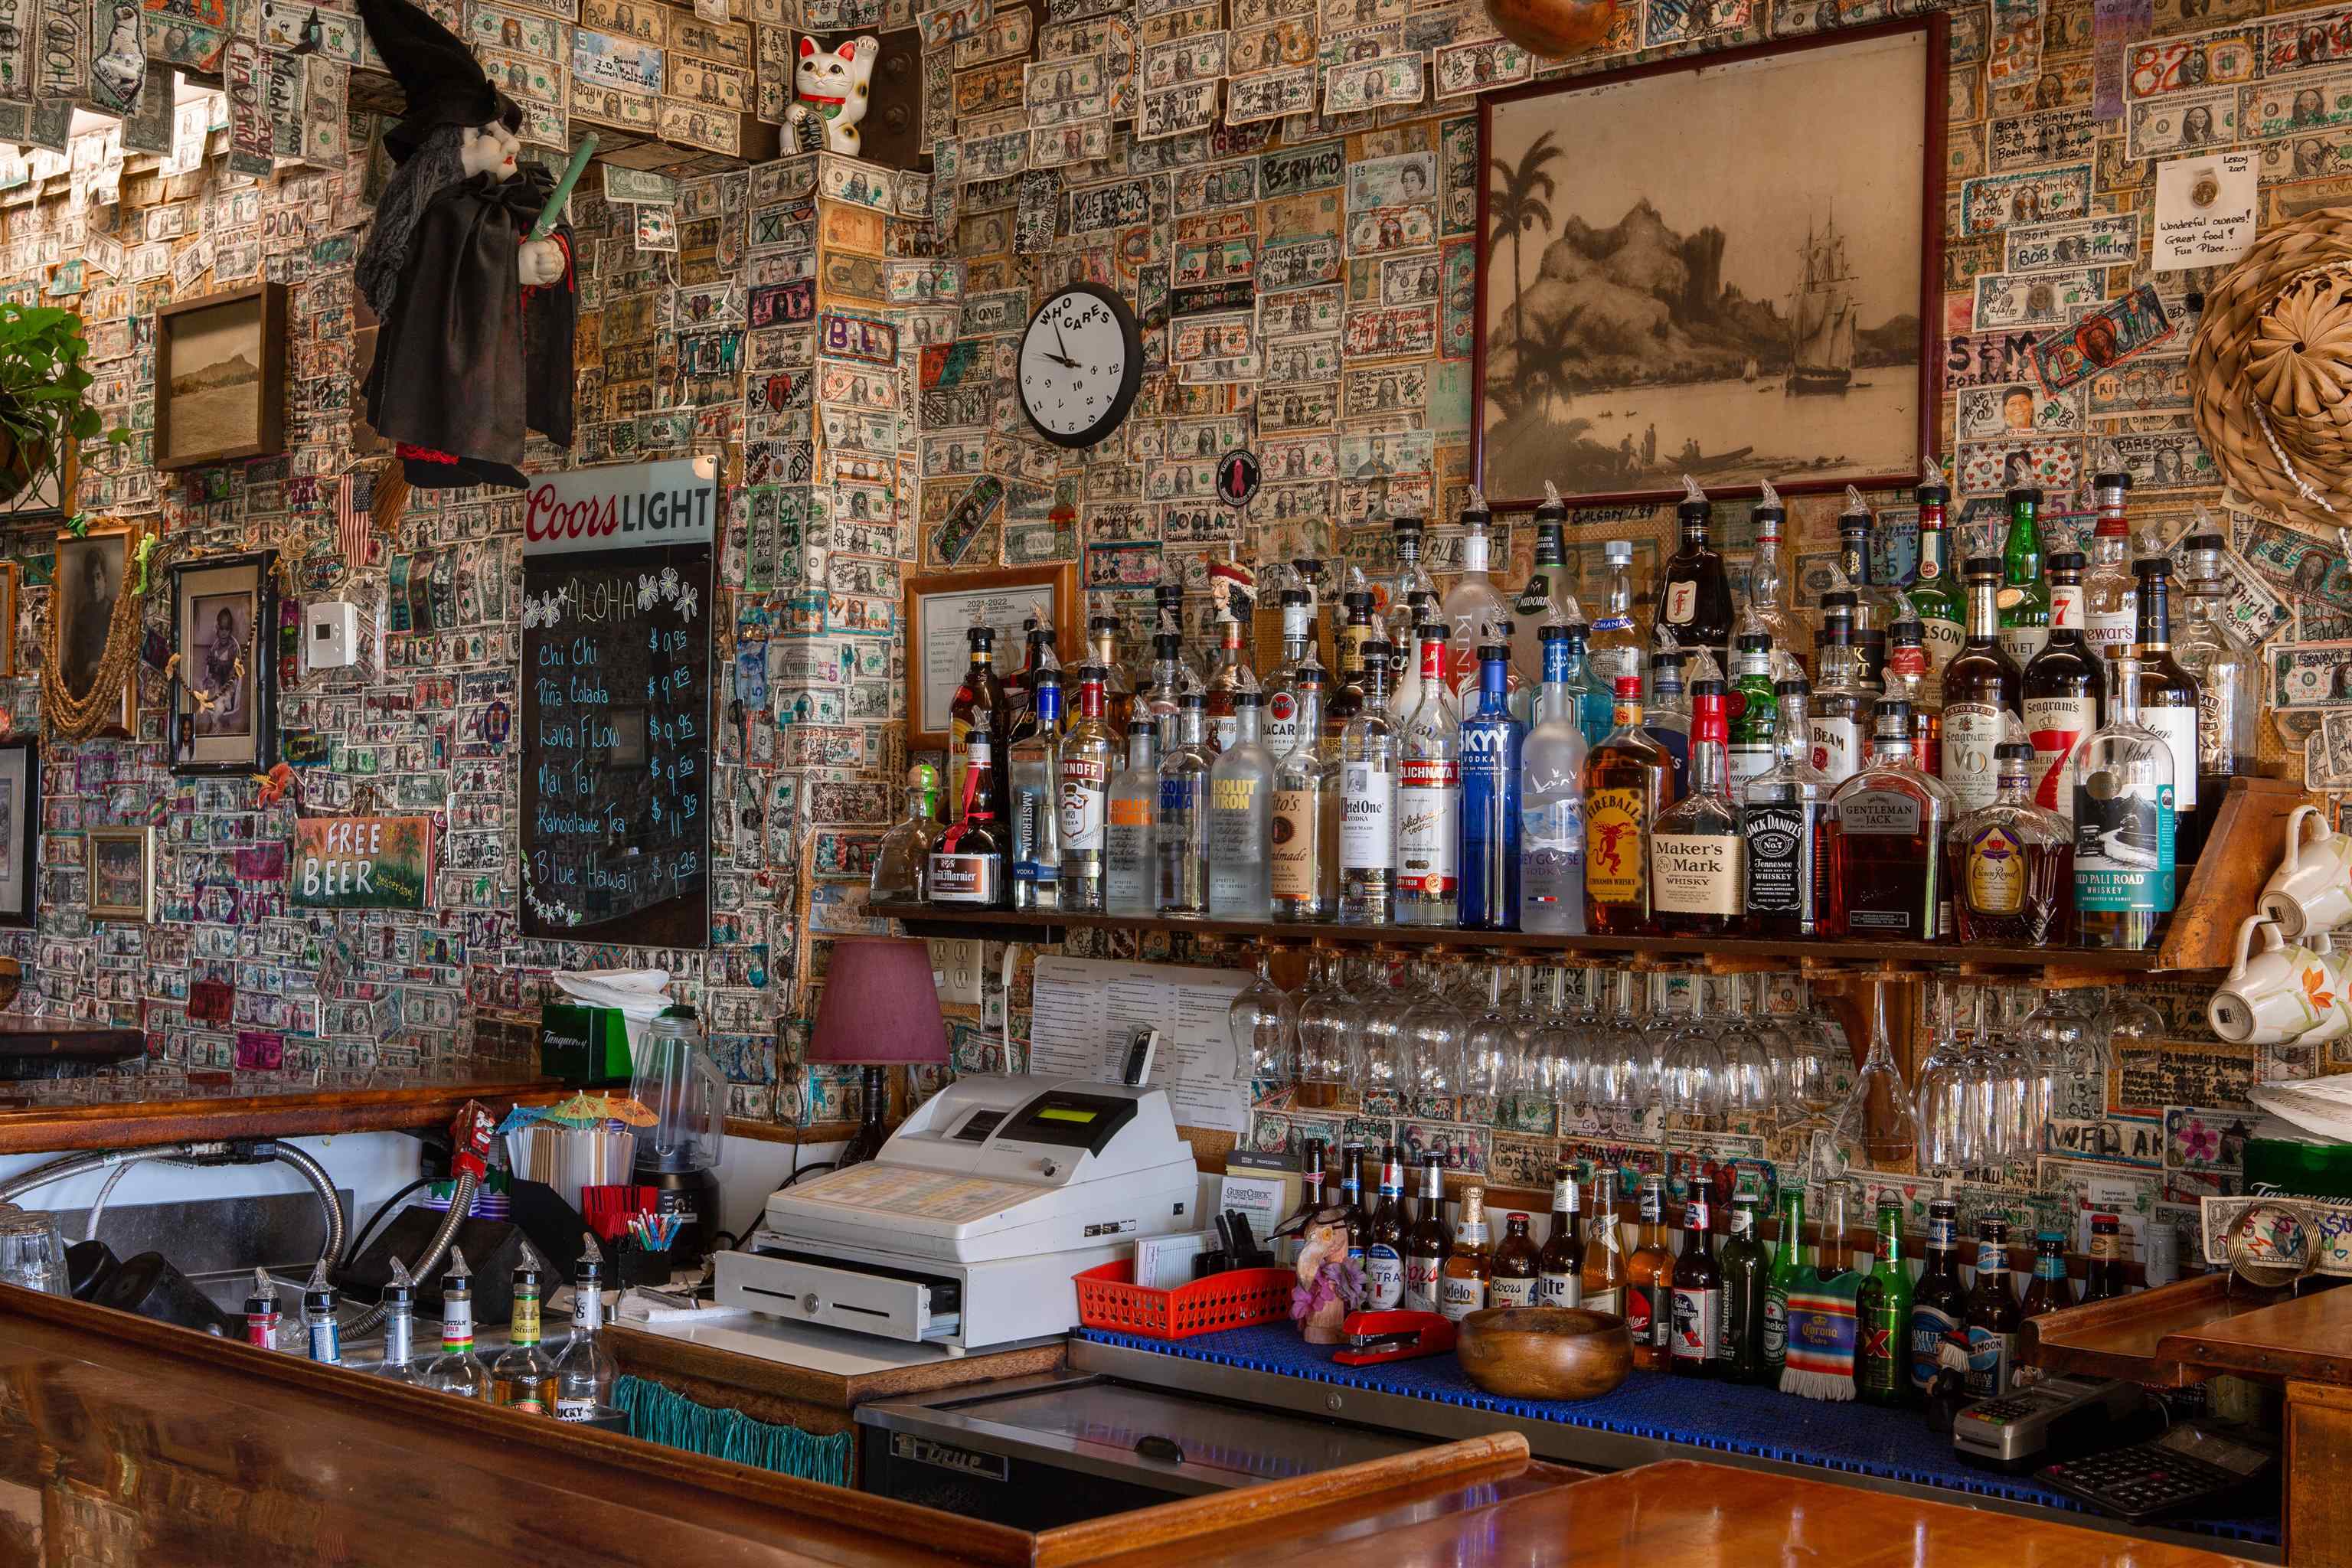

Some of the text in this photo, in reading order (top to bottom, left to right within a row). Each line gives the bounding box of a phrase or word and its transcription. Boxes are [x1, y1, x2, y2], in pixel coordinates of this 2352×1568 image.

[577, 31, 588, 49] 5
[578, 84, 603, 99] JOHN
[1995, 122, 2019, 132] BOB
[1264, 153, 1340, 191] BERNARD
[1354, 166, 1367, 177] £5
[1075, 182, 1143, 211] VICTORIA
[2019, 249, 2048, 265] BOB
[2174, 246, 2192, 256] Fun
[1040, 298, 1072, 325] WHO
[1063, 304, 1109, 330] CARES
[1947, 330, 2037, 371] S M
[1108, 363, 1120, 375] 12
[1073, 381, 1083, 392] 10
[1947, 369, 2027, 387] FOREVER
[1034, 400, 1043, 413] 11
[1057, 398, 1064, 409] 7
[771, 443, 788, 458] Lite
[526, 484, 711, 541] Coors LIGHT
[567, 578, 635, 622] ALOHA
[2053, 599, 2071, 626] 7
[540, 645, 564, 666] Chi
[573, 637, 596, 665] Chi
[571, 676, 608, 704] Colada
[2027, 700, 2079, 714] Seagram's
[541, 720, 572, 748] Lava
[538, 763, 560, 798] Mai
[572, 759, 593, 795] Tai
[2029, 728, 2082, 812] 7
[1361, 799, 1383, 815] One
[1587, 795, 1640, 820] FIREBALL
[1846, 805, 1912, 815] GENTLEMAN
[604, 802, 625, 832] Tea
[1022, 791, 1034, 852] AMSTERDAM
[1866, 815, 1892, 825] JACK
[1746, 814, 1804, 838] JACK DANIEL'S
[326, 821, 381, 855] FREE
[1656, 841, 1723, 855] Maker's
[534, 850, 576, 884] Blue
[1673, 860, 1722, 873] Mark
[1755, 858, 1792, 867] Tennessee
[303, 858, 374, 896] BEER
[1665, 878, 1710, 887] WHISKY
[2090, 874, 2109, 884] PALI
[2114, 874, 2144, 884] ROAD
[1576, 1144, 1653, 1161] SHAWNEE
[1445, 1282, 1470, 1300] odelo
[1494, 1279, 1521, 1293] Coors
[1802, 1322, 1838, 1337] Corona
[1978, 1341, 2002, 1353] MOON
